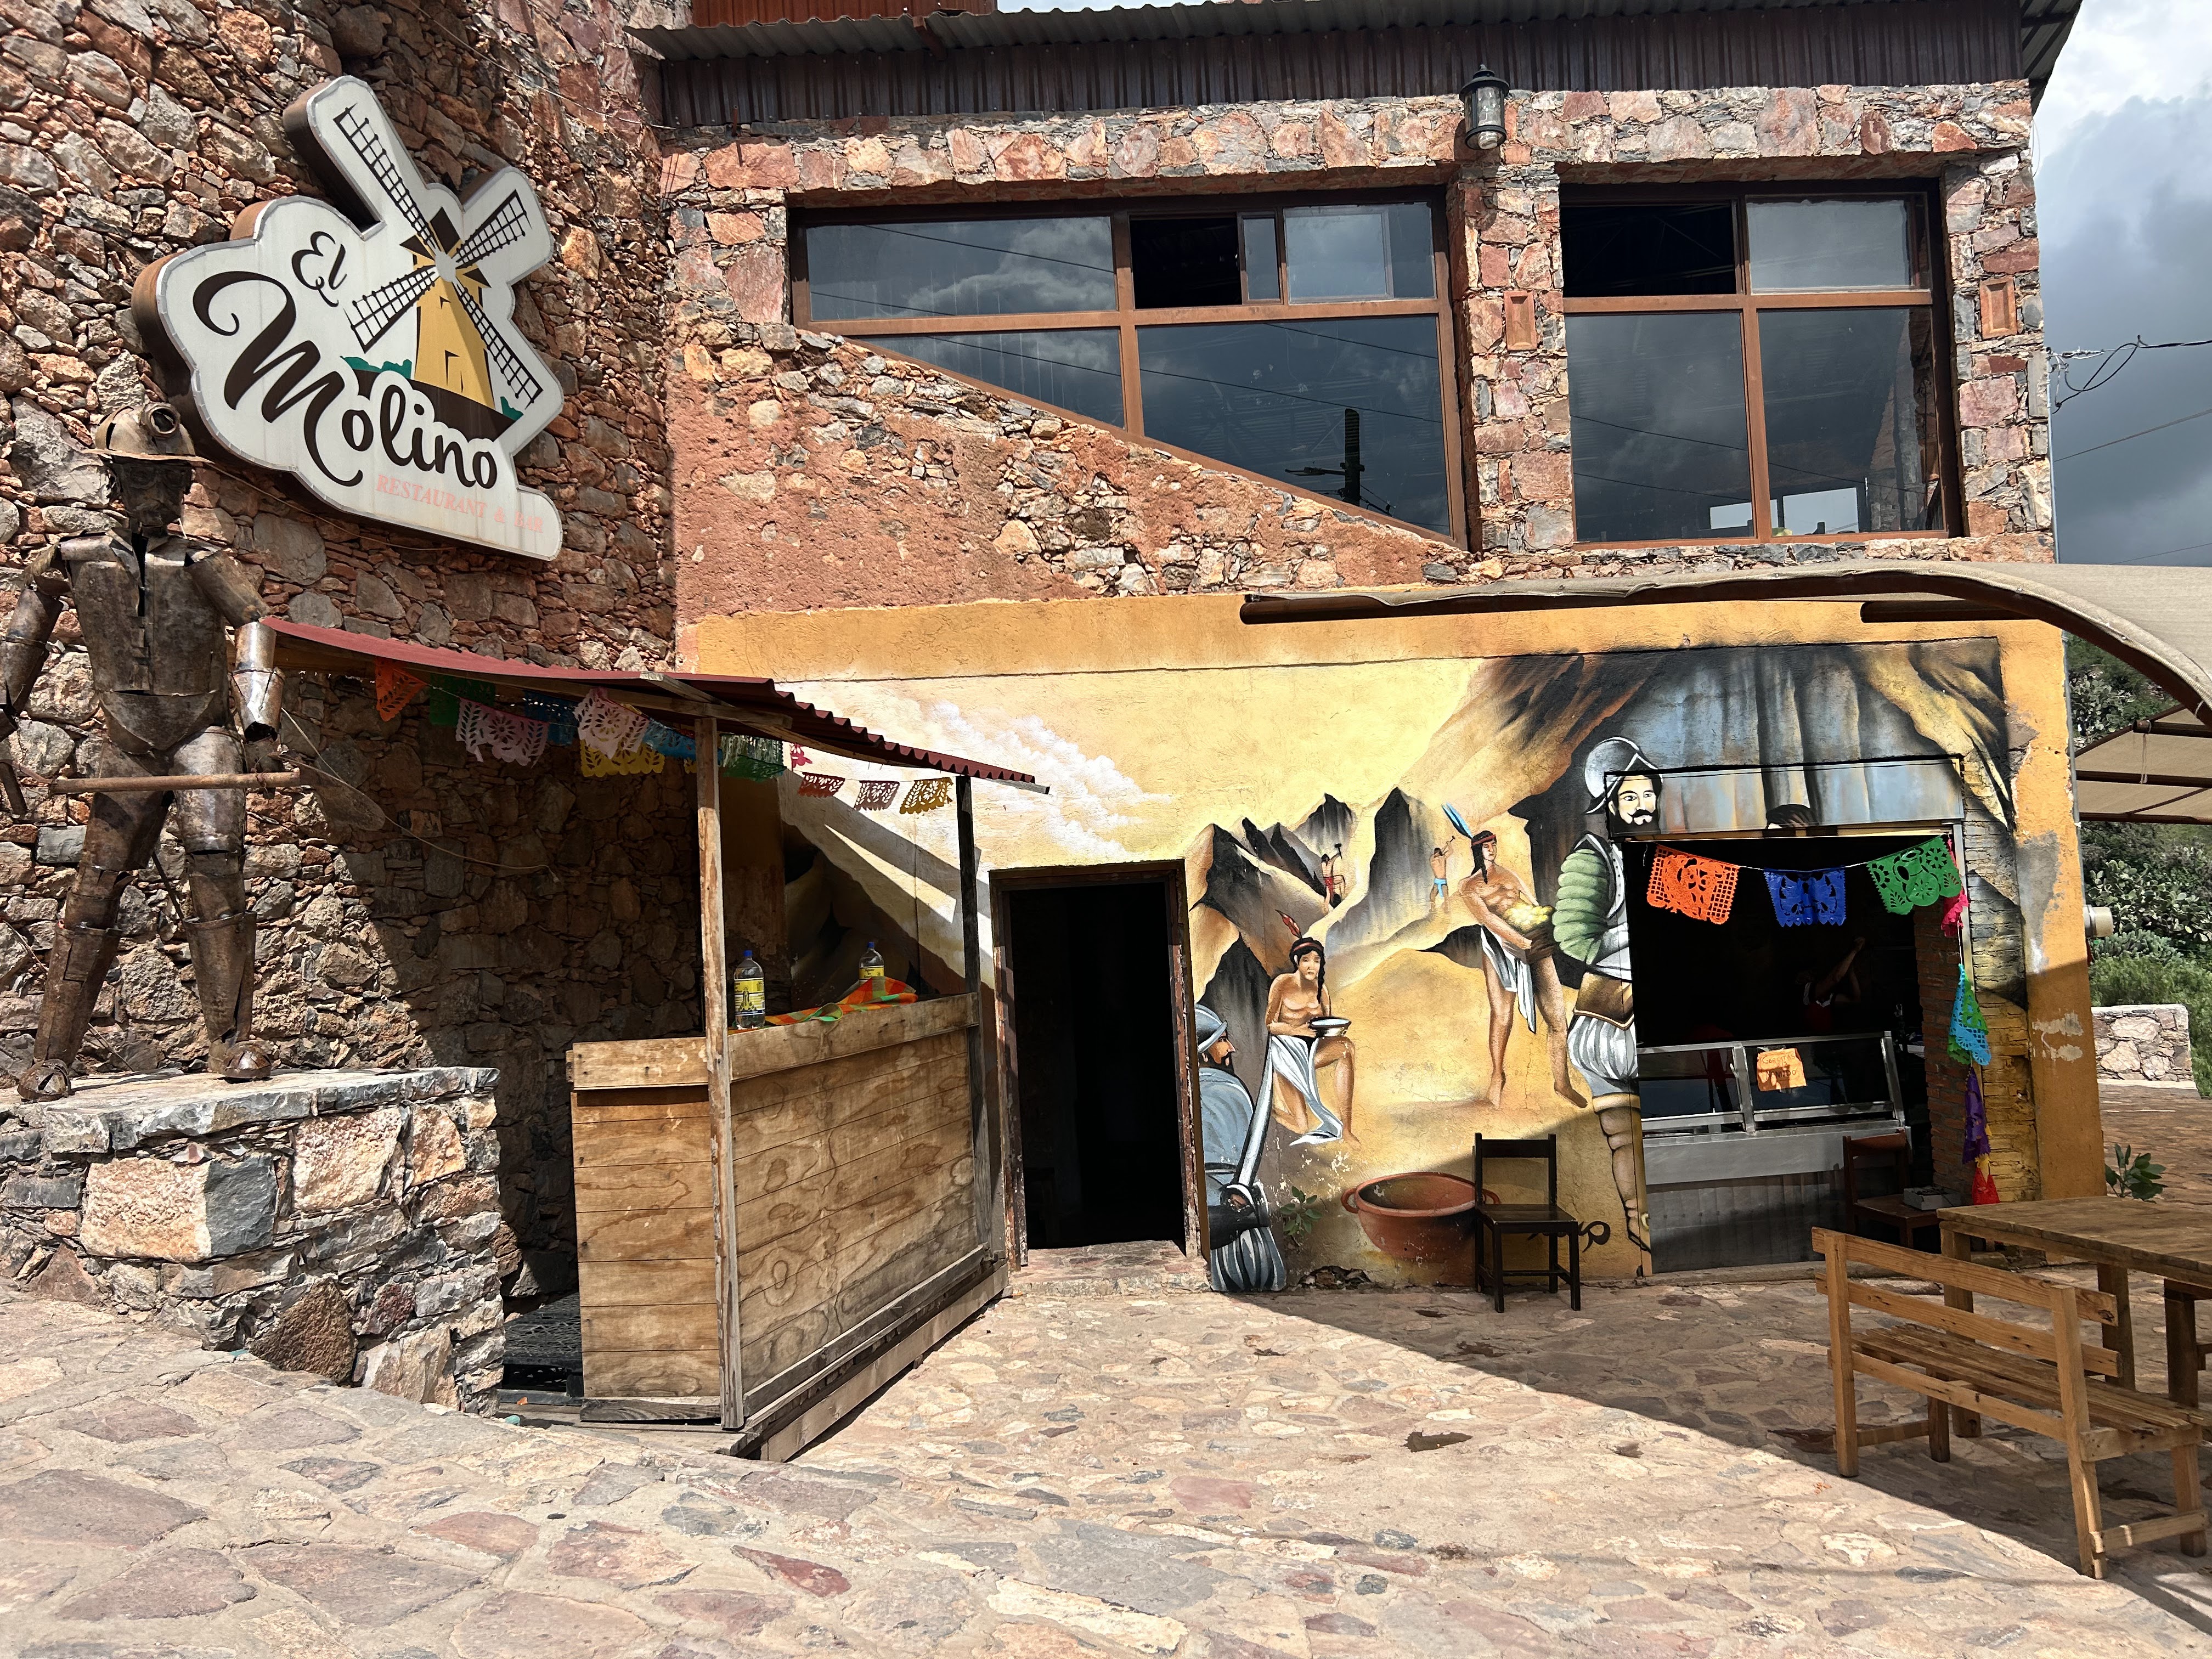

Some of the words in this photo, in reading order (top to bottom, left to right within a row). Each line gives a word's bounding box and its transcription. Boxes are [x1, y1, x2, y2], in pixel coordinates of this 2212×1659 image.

[291, 231, 346, 307] El
[193, 271, 497, 488] Molino
[375, 474, 487, 518] RESTAURANT
[493, 506, 505, 523] &
[514, 511, 544, 533] BAR
[1762, 1054, 1796, 1064] GORDITAS
